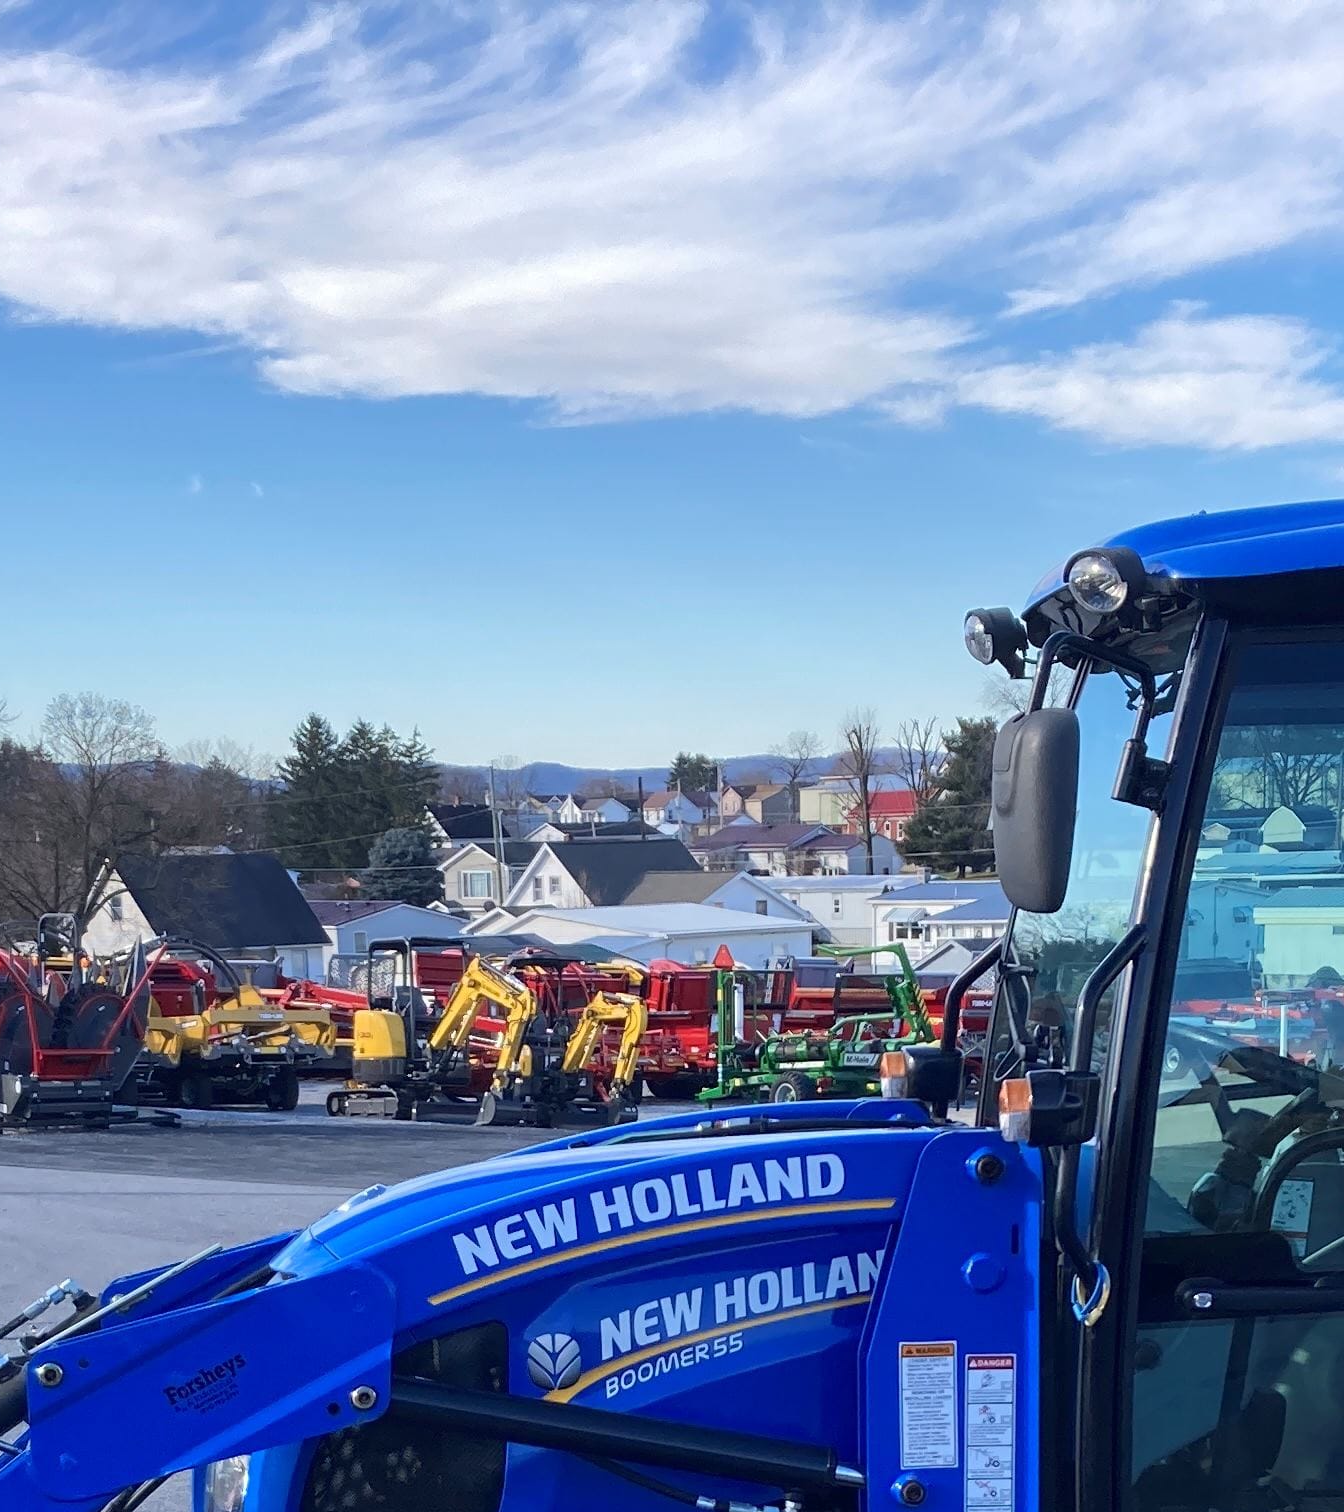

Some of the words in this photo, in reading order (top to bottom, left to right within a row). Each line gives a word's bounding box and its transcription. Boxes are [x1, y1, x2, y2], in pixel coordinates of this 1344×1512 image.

[452, 1199, 580, 1275] NEW
[590, 1153, 845, 1234] HOLLAND
[599, 1287, 706, 1361] NEW
[713, 1249, 886, 1325] HOLLAN
[163, 1354, 246, 1405] Forsheys
[605, 1343, 710, 1399] BOOMER
[713, 1331, 744, 1358] 55
[977, 1359, 1013, 1367] DANGER
